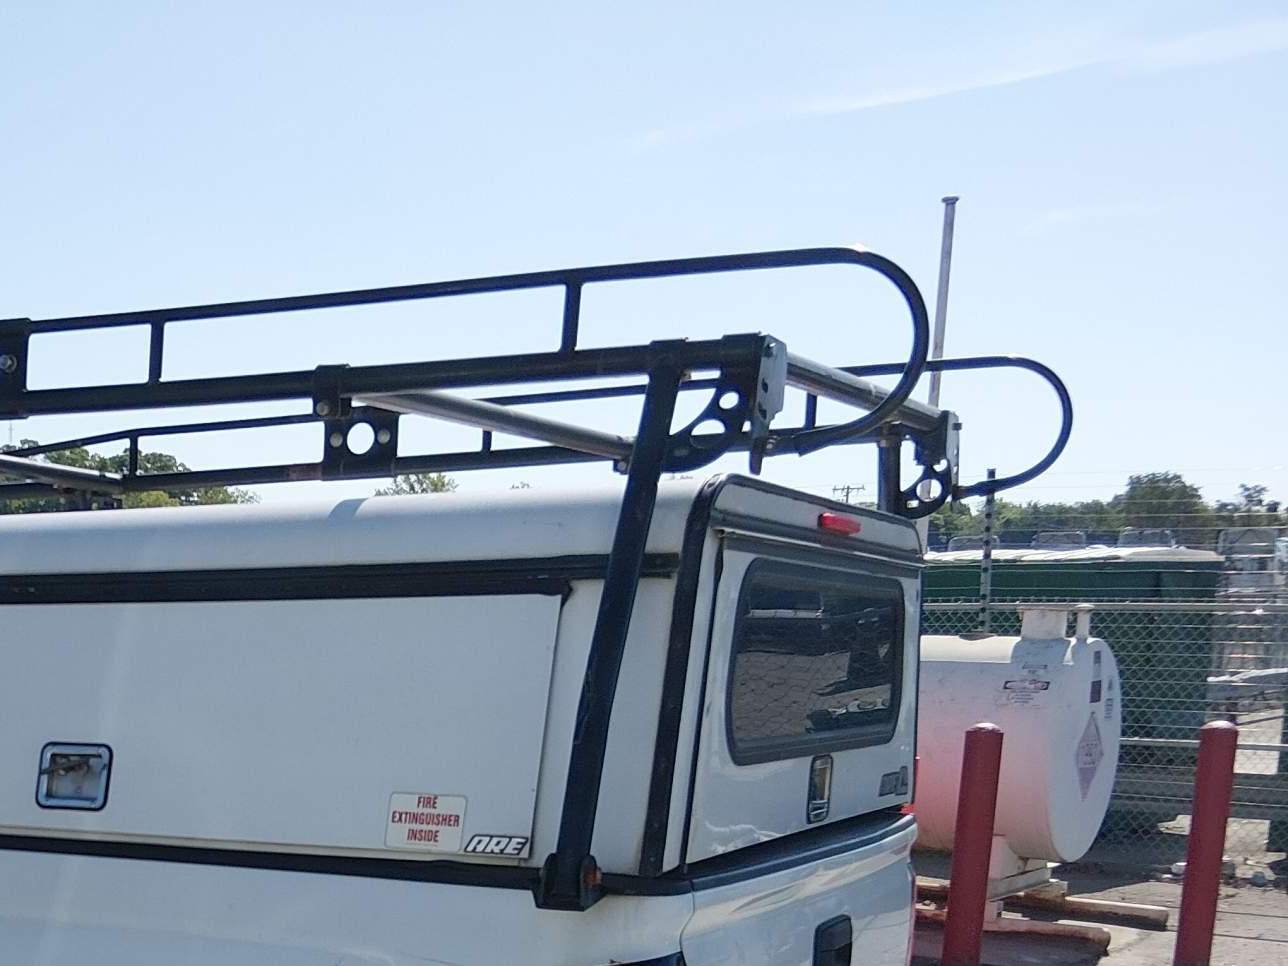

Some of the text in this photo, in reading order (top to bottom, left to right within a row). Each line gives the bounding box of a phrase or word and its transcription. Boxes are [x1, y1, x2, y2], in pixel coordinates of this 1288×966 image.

[417, 796, 438, 809] FIRE
[391, 810, 460, 828] EXTINGUISHER
[406, 829, 440, 843] INSIDE
[464, 833, 529, 856] ARE
